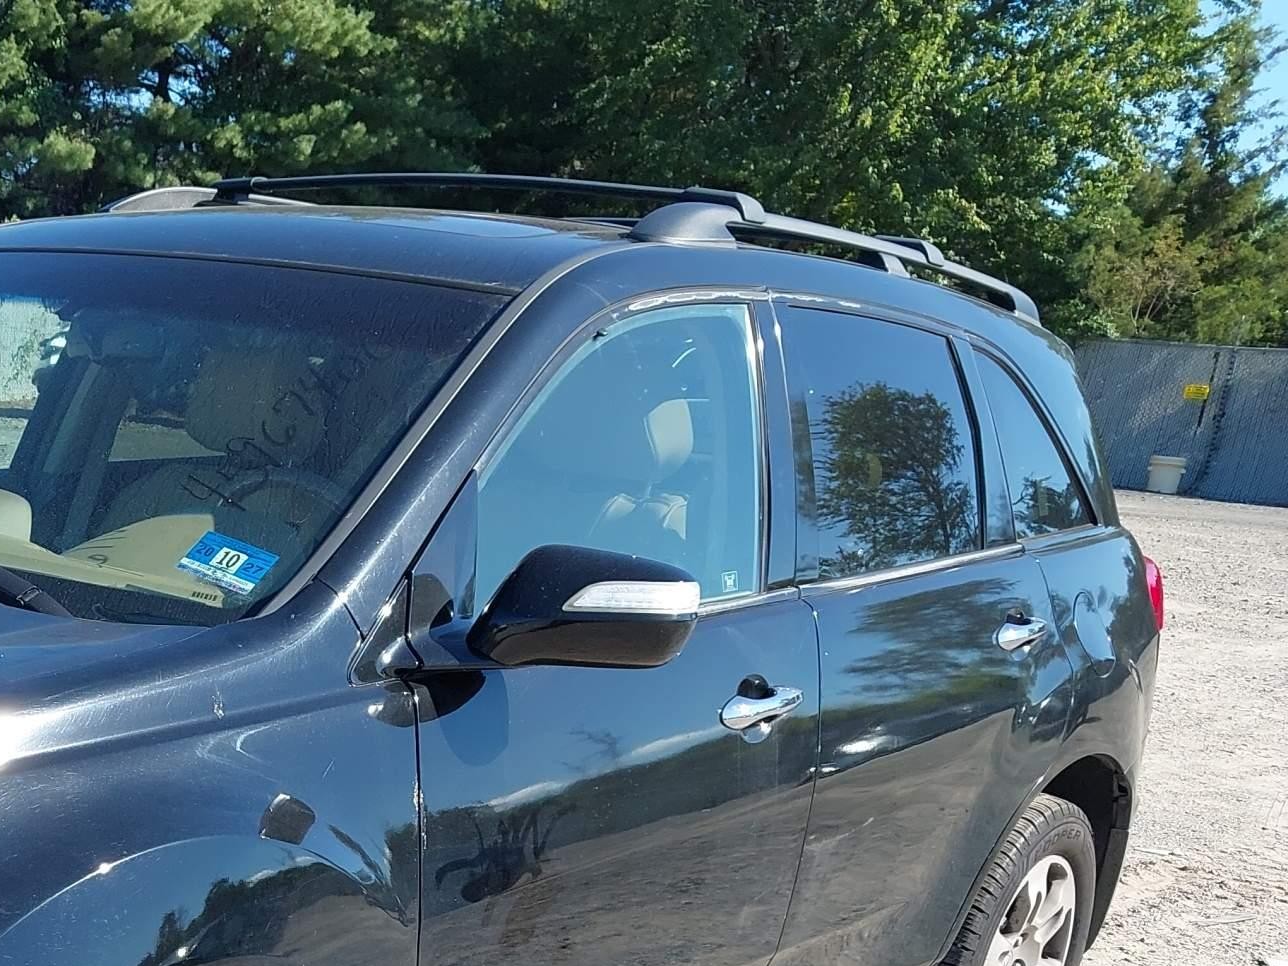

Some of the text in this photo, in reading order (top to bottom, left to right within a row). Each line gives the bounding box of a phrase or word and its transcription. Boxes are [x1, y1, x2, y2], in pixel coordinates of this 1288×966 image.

[196, 541, 215, 557] 20
[215, 550, 241, 569] 10
[242, 562, 265, 576] 27
